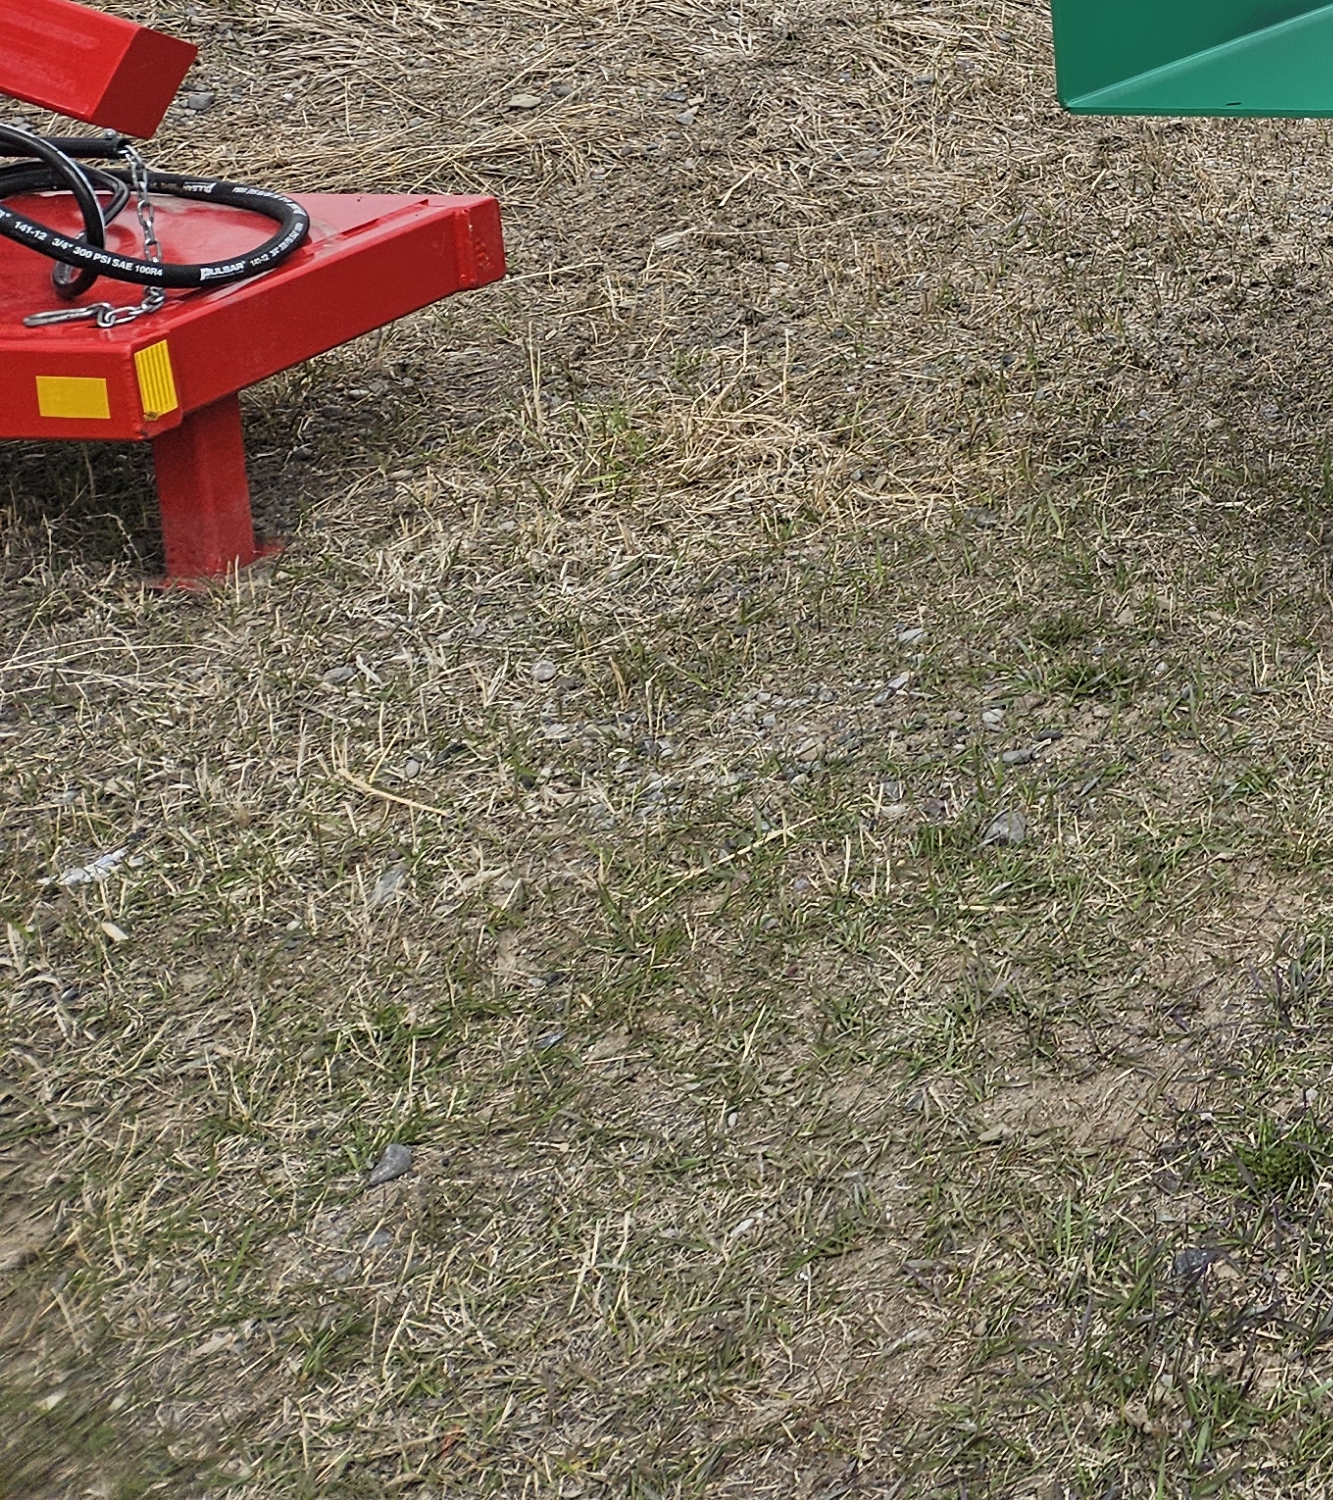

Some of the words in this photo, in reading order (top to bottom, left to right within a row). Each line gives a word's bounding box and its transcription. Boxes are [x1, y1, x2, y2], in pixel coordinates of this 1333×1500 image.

[14, 220, 48, 241] 141-12
[72, 246, 93, 259] 300
[93, 253, 112, 265] PSI
[112, 259, 133, 272] SAE
[134, 264, 163, 277] 100R4
